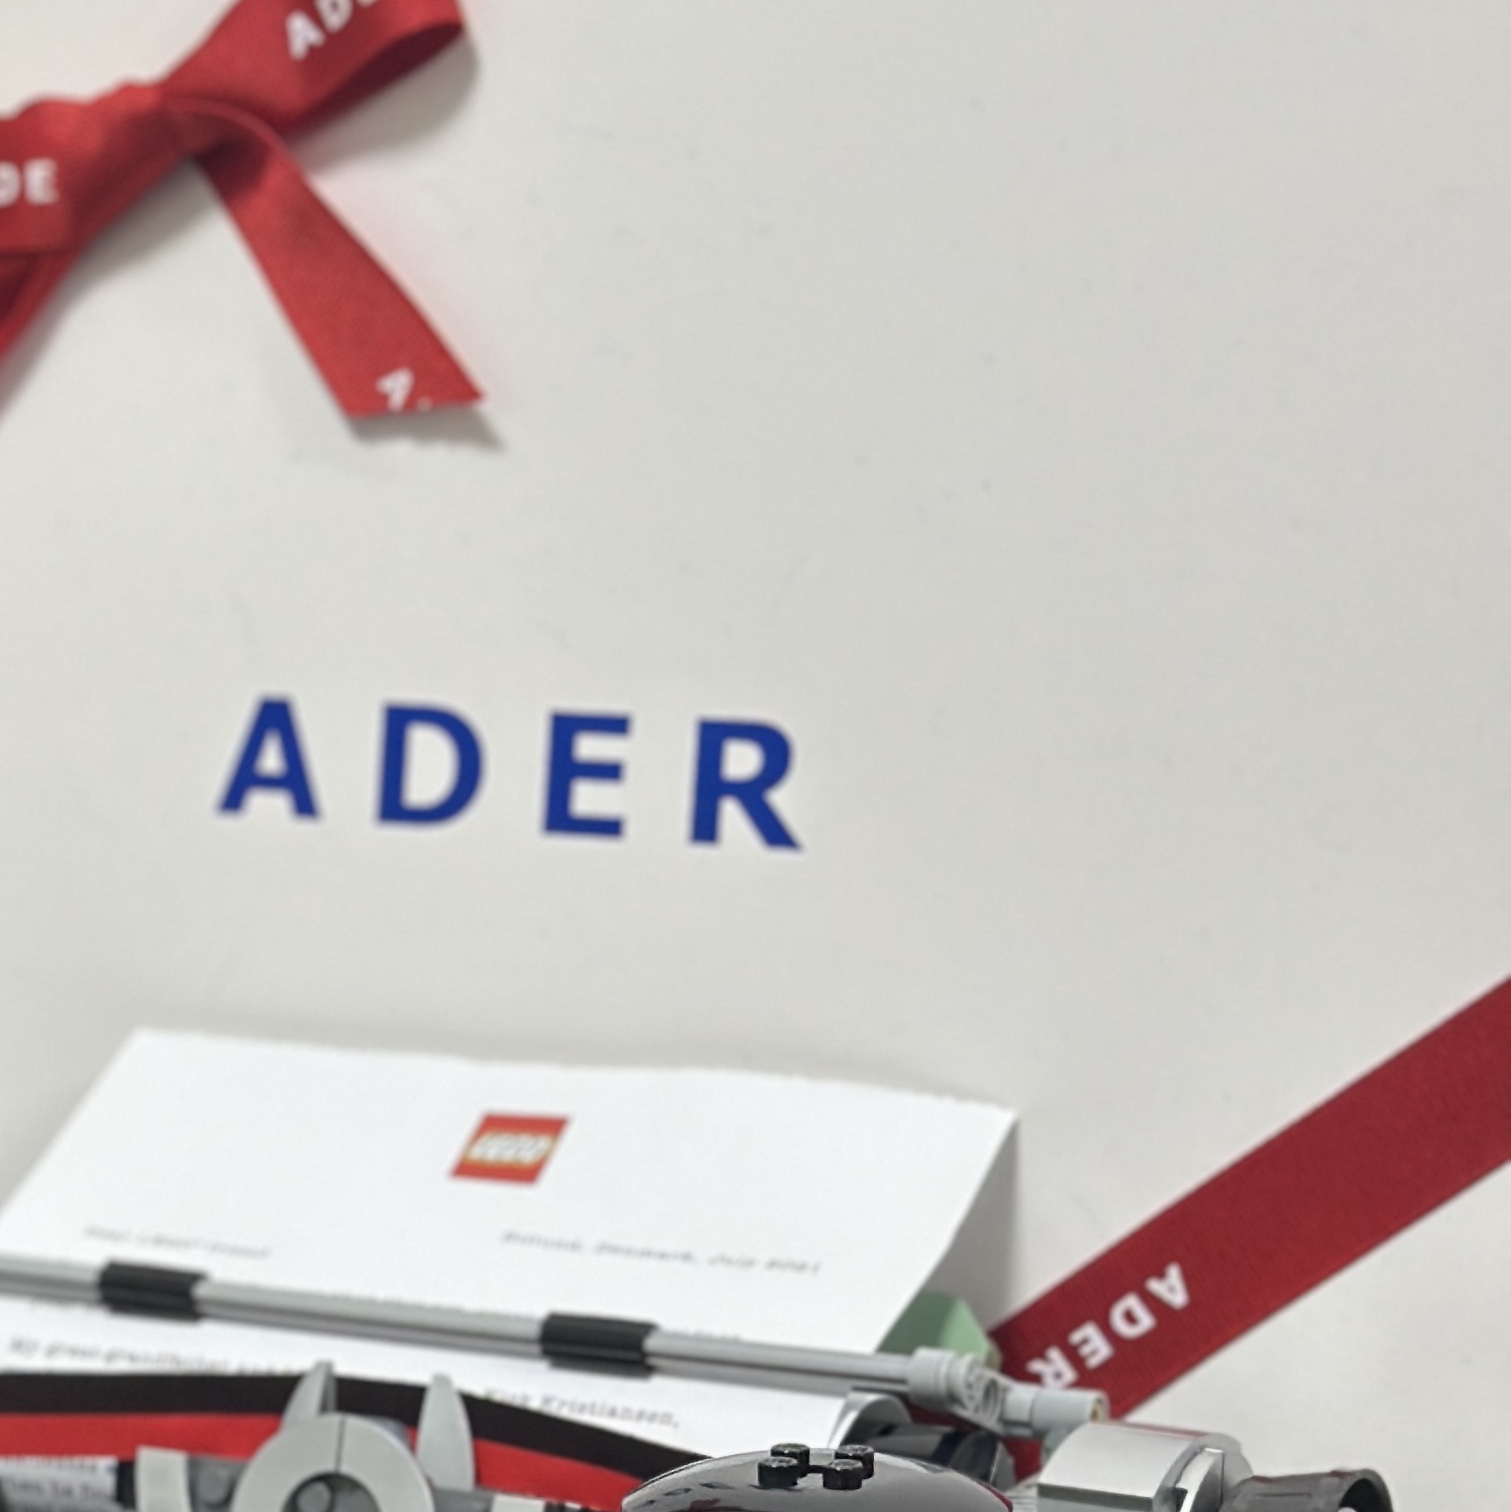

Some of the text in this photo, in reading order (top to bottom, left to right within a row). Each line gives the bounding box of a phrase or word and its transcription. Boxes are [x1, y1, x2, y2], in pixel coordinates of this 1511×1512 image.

[284, 0, 380, 62] AD
[216, 695, 804, 853] ADER
[1025, 1262, 1190, 1390] ADER
